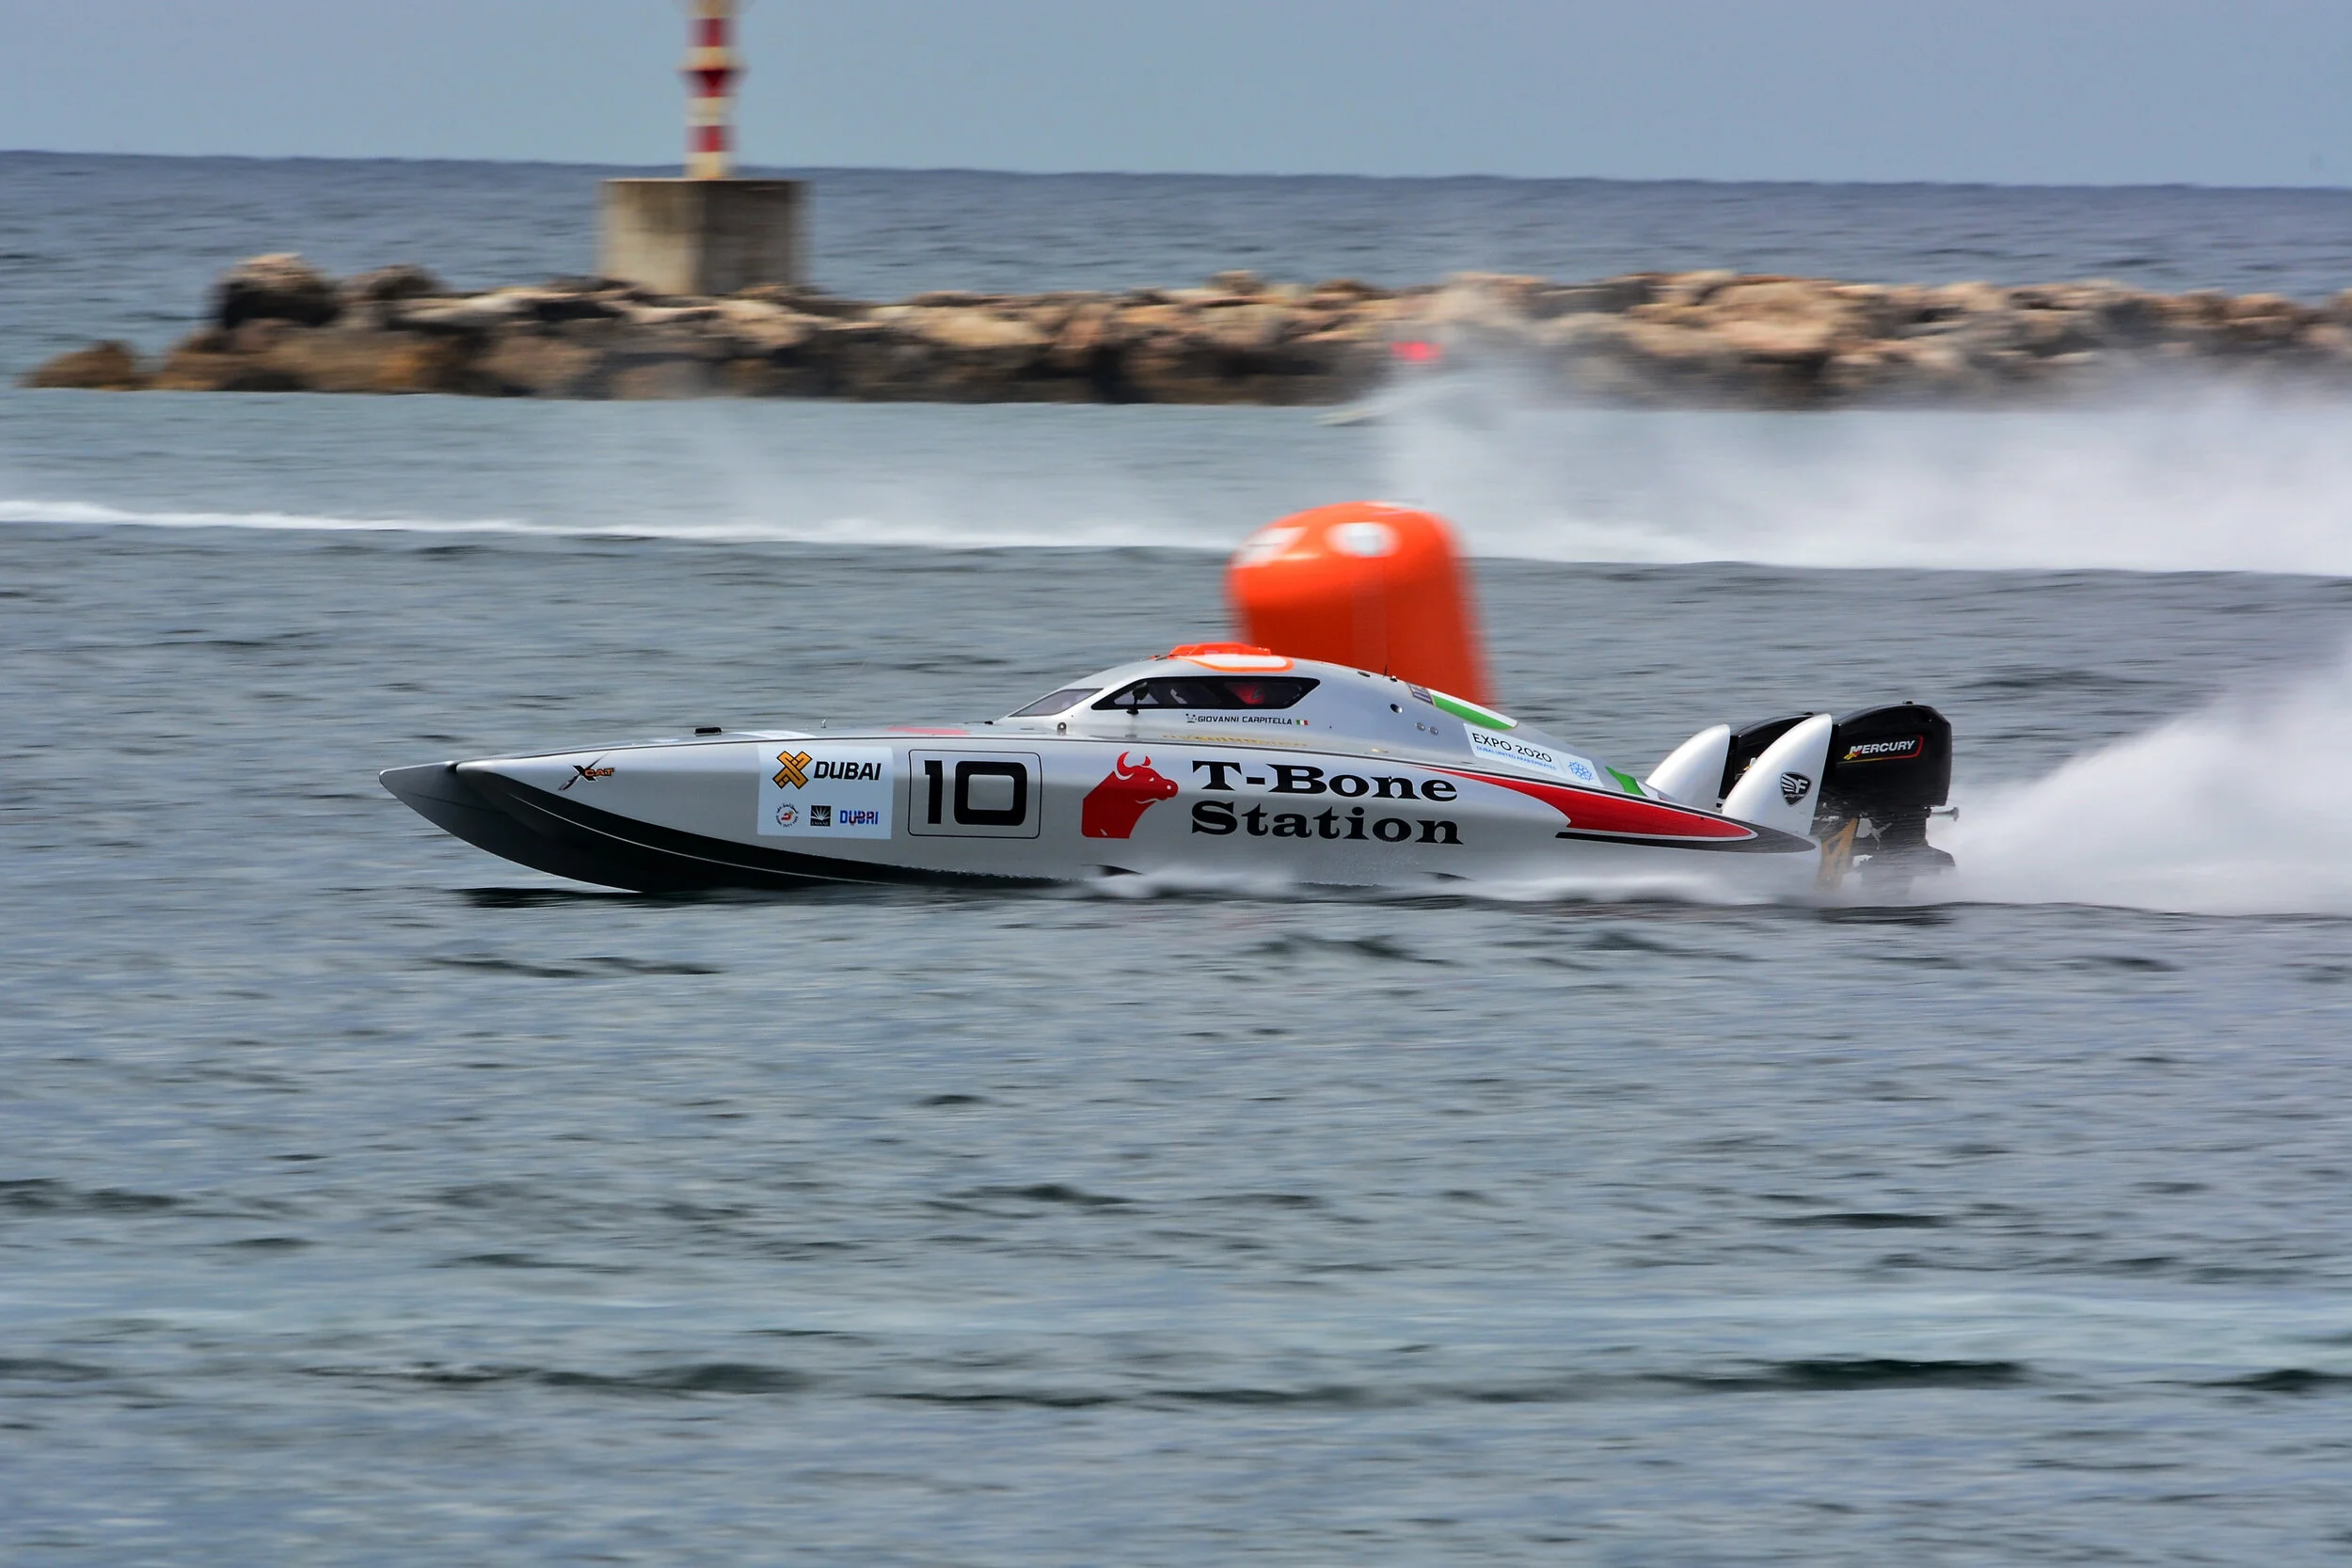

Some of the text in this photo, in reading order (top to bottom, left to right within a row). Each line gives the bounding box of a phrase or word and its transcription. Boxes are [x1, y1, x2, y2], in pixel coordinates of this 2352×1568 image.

[1242, 716, 1293, 725] CARPITELLA
[1471, 732, 1552, 763] EXPO 2020
[1849, 739, 1915, 755] MERCURY
[813, 761, 882, 781] DUBAI
[1191, 759, 1458, 802] T-Bone
[924, 759, 1027, 827] 10
[839, 810, 879, 826] DUBAI
[1191, 800, 1465, 846] Station
